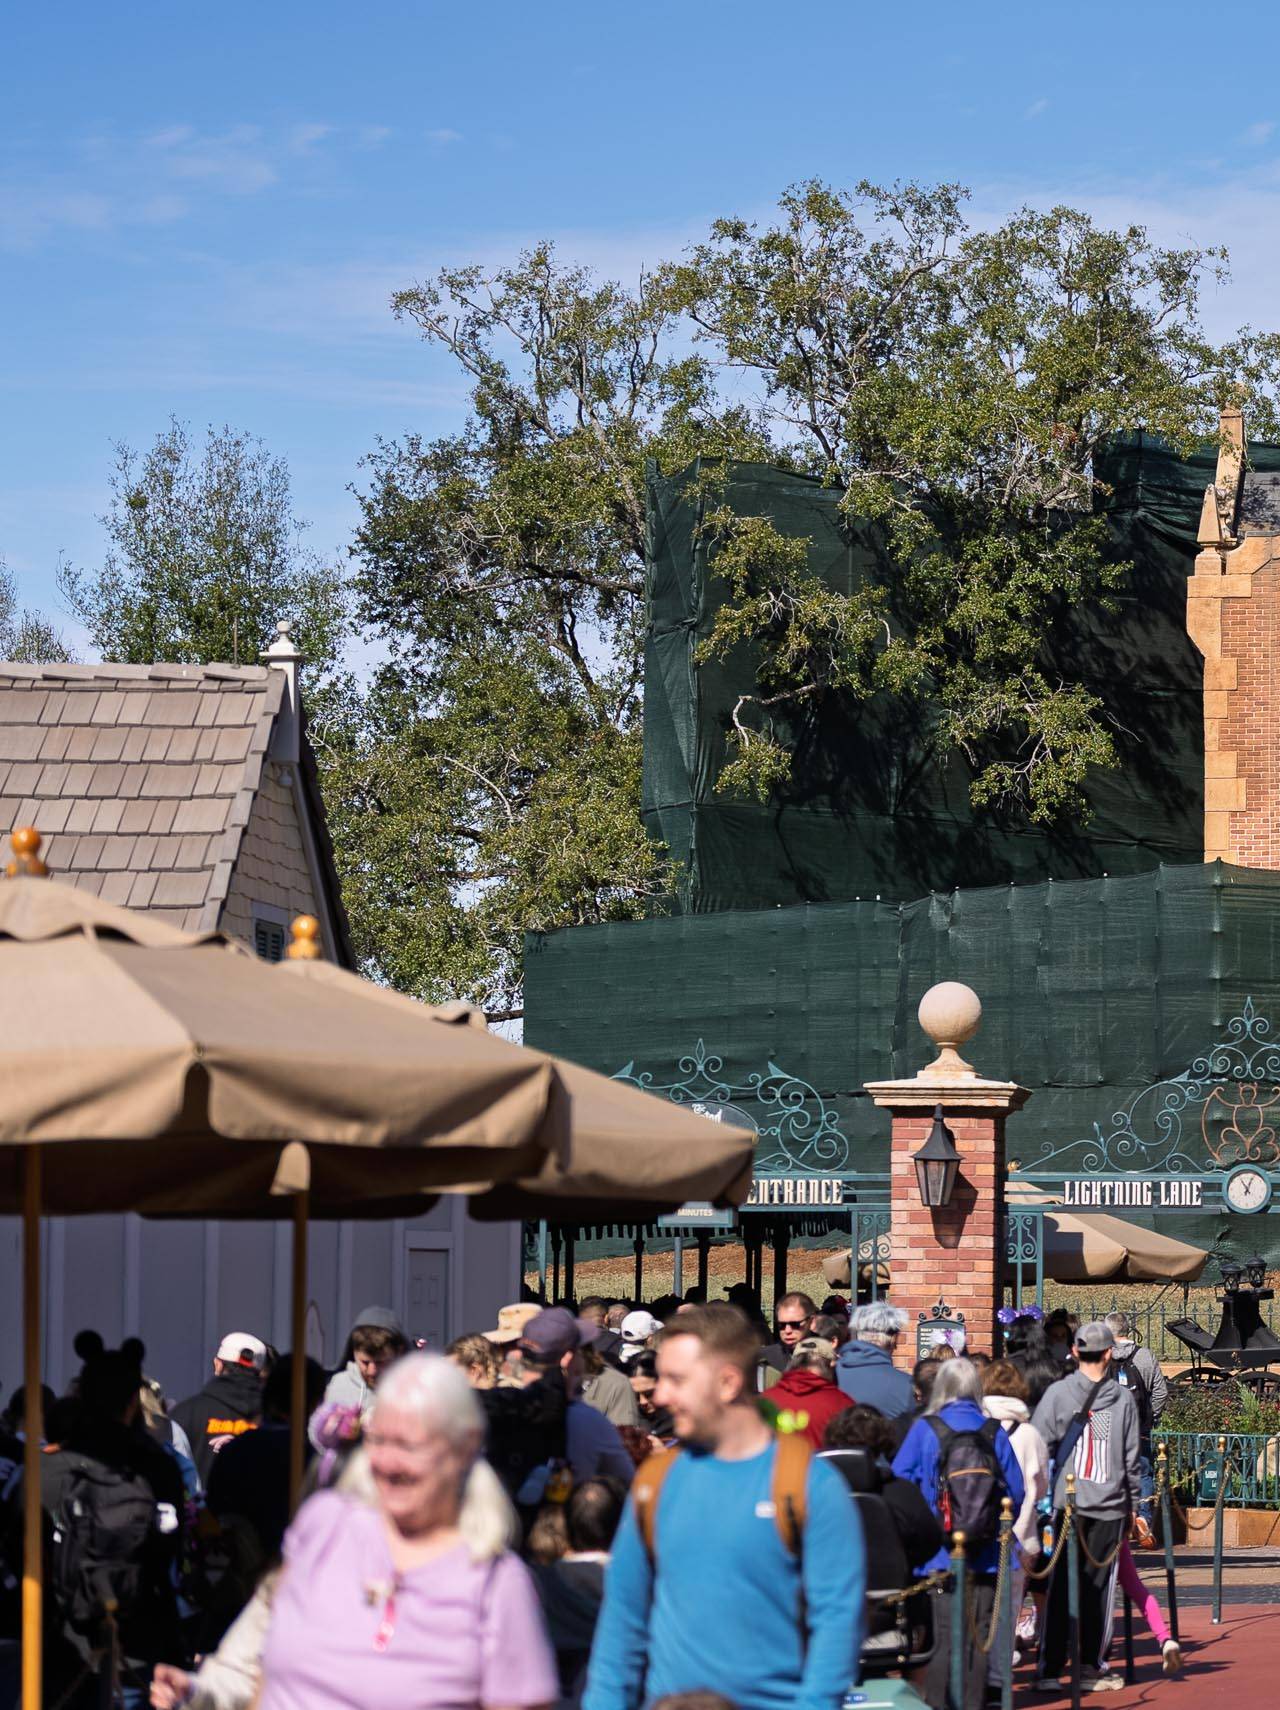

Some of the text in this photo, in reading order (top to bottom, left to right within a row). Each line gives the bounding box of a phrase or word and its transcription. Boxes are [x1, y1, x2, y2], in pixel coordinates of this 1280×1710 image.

[746, 1178, 843, 1205] ENTRANCE
[1063, 1180, 1152, 1206] LIGHTNING
[1160, 1180, 1202, 1206] LANE
[677, 1208, 714, 1217] MINUTES
